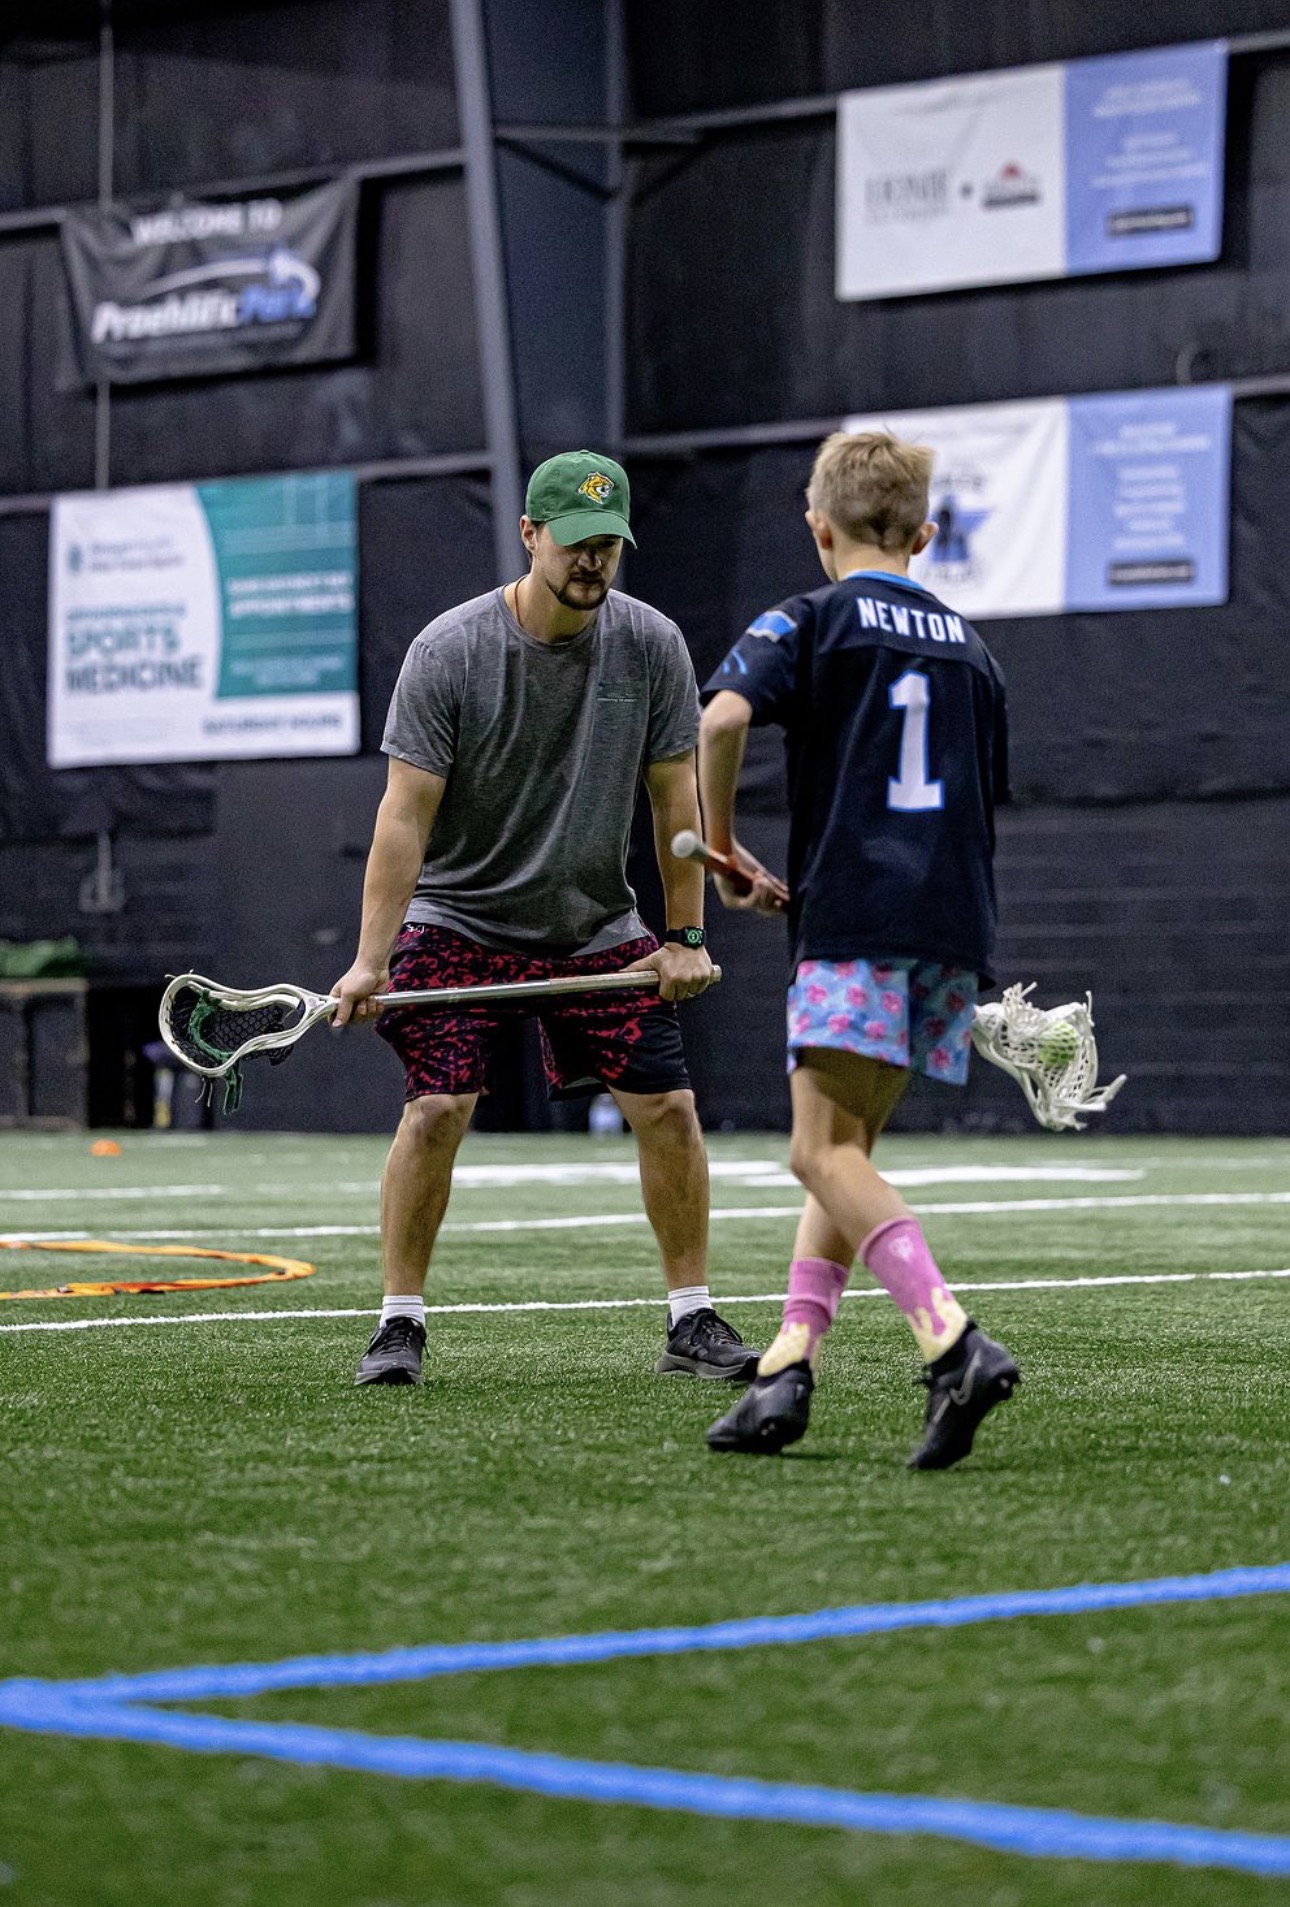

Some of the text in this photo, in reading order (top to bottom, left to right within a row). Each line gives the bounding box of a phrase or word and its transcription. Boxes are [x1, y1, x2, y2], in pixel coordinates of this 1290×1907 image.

[131, 198, 282, 246] WELCOME TO
[67, 624, 180, 657] SPORTS
[856, 597, 966, 644] NEWTON
[66, 657, 202, 693] MEDICINE
[886, 669, 944, 812] 1
